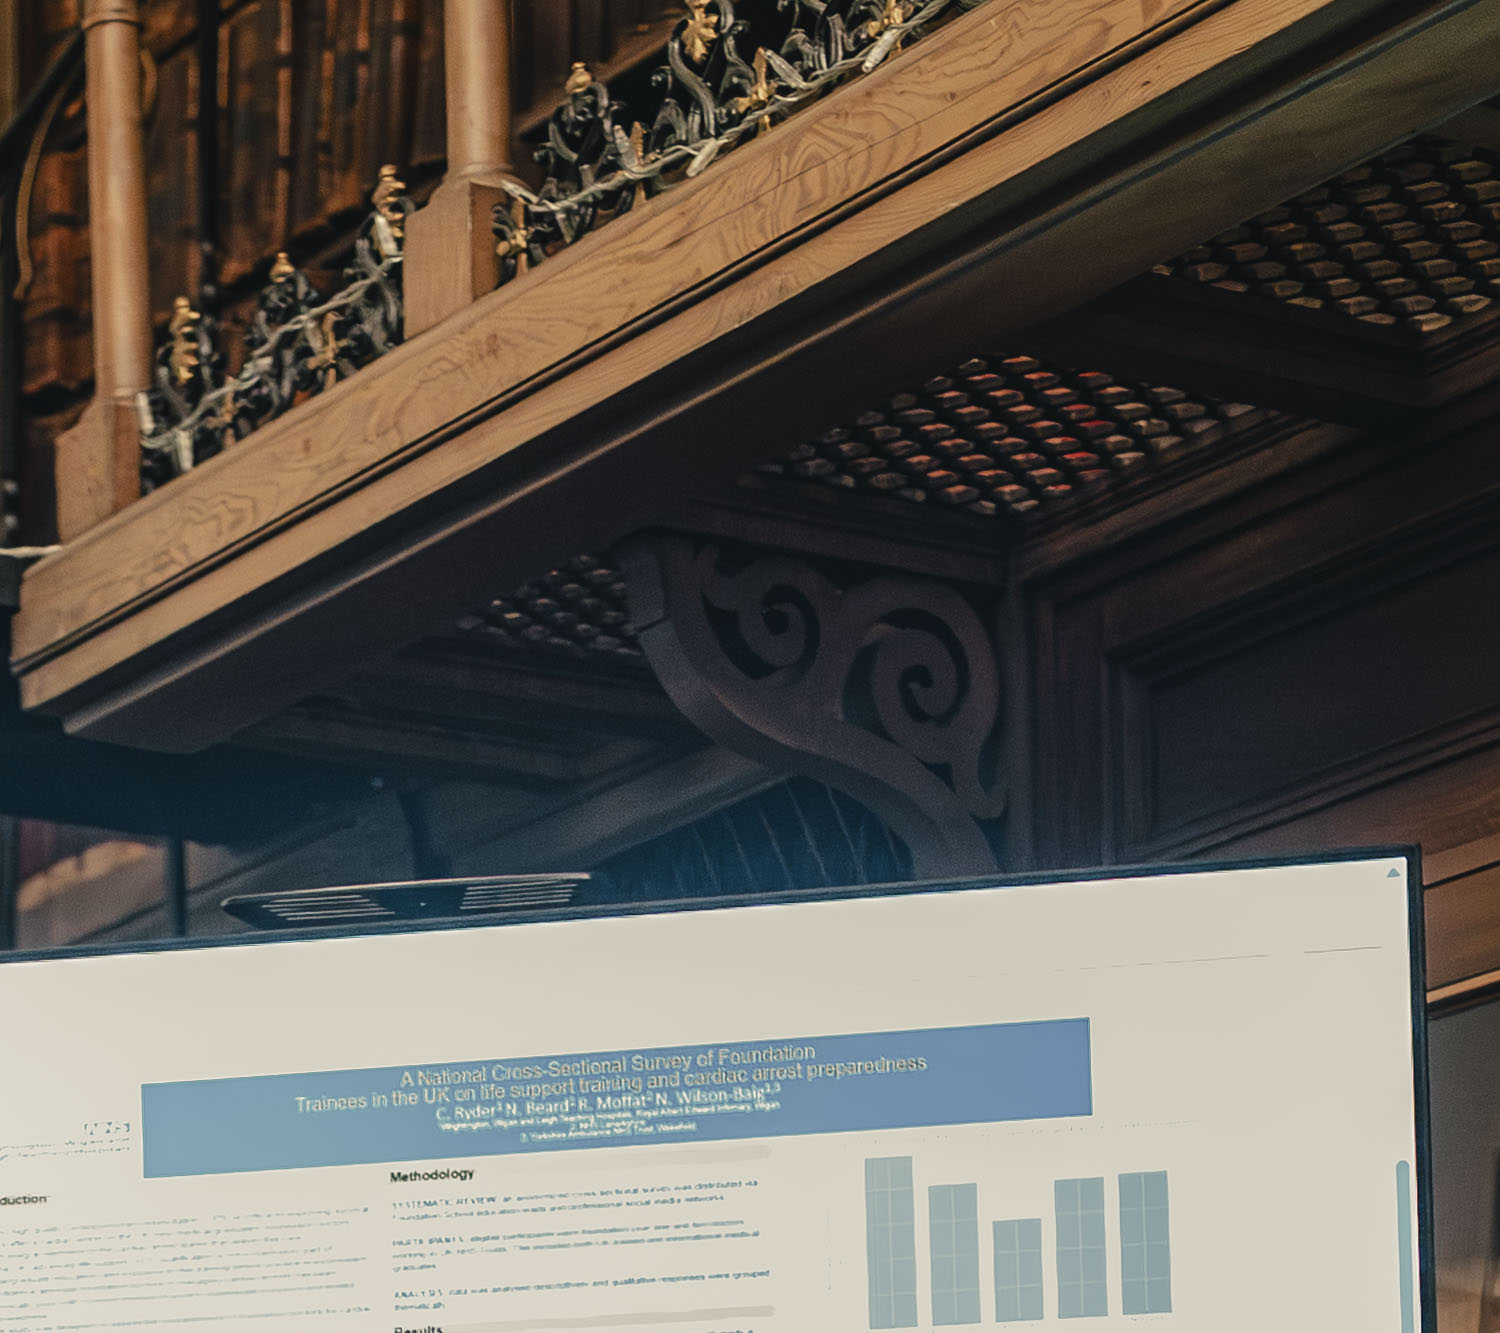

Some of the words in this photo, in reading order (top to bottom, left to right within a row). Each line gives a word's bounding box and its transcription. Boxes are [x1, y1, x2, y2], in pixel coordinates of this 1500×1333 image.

[296, 1093, 367, 1112] Trainees
[372, 1091, 387, 1108] in
[391, 1090, 418, 1106] the
[423, 1087, 450, 1104] UK
[455, 1087, 476, 1102] on
[480, 1083, 505, 1100] life
[510, 1078, 576, 1101] support
[579, 1073, 642, 1094] training
[647, 1070, 680, 1089] and
[684, 1067, 748, 1086] cardiac
[752, 1063, 803, 1081] arrest
[807, 1055, 928, 1082] preparedness
[400, 1071, 413, 1087] A
[417, 1067, 486, 1086] National
[491, 1056, 626, 1082] Cross-Sectional
[631, 1055, 692, 1073] Survey
[696, 1049, 713, 1067] of
[718, 1045, 816, 1066] Foundation
[390, 1168, 474, 1184] Methodology
